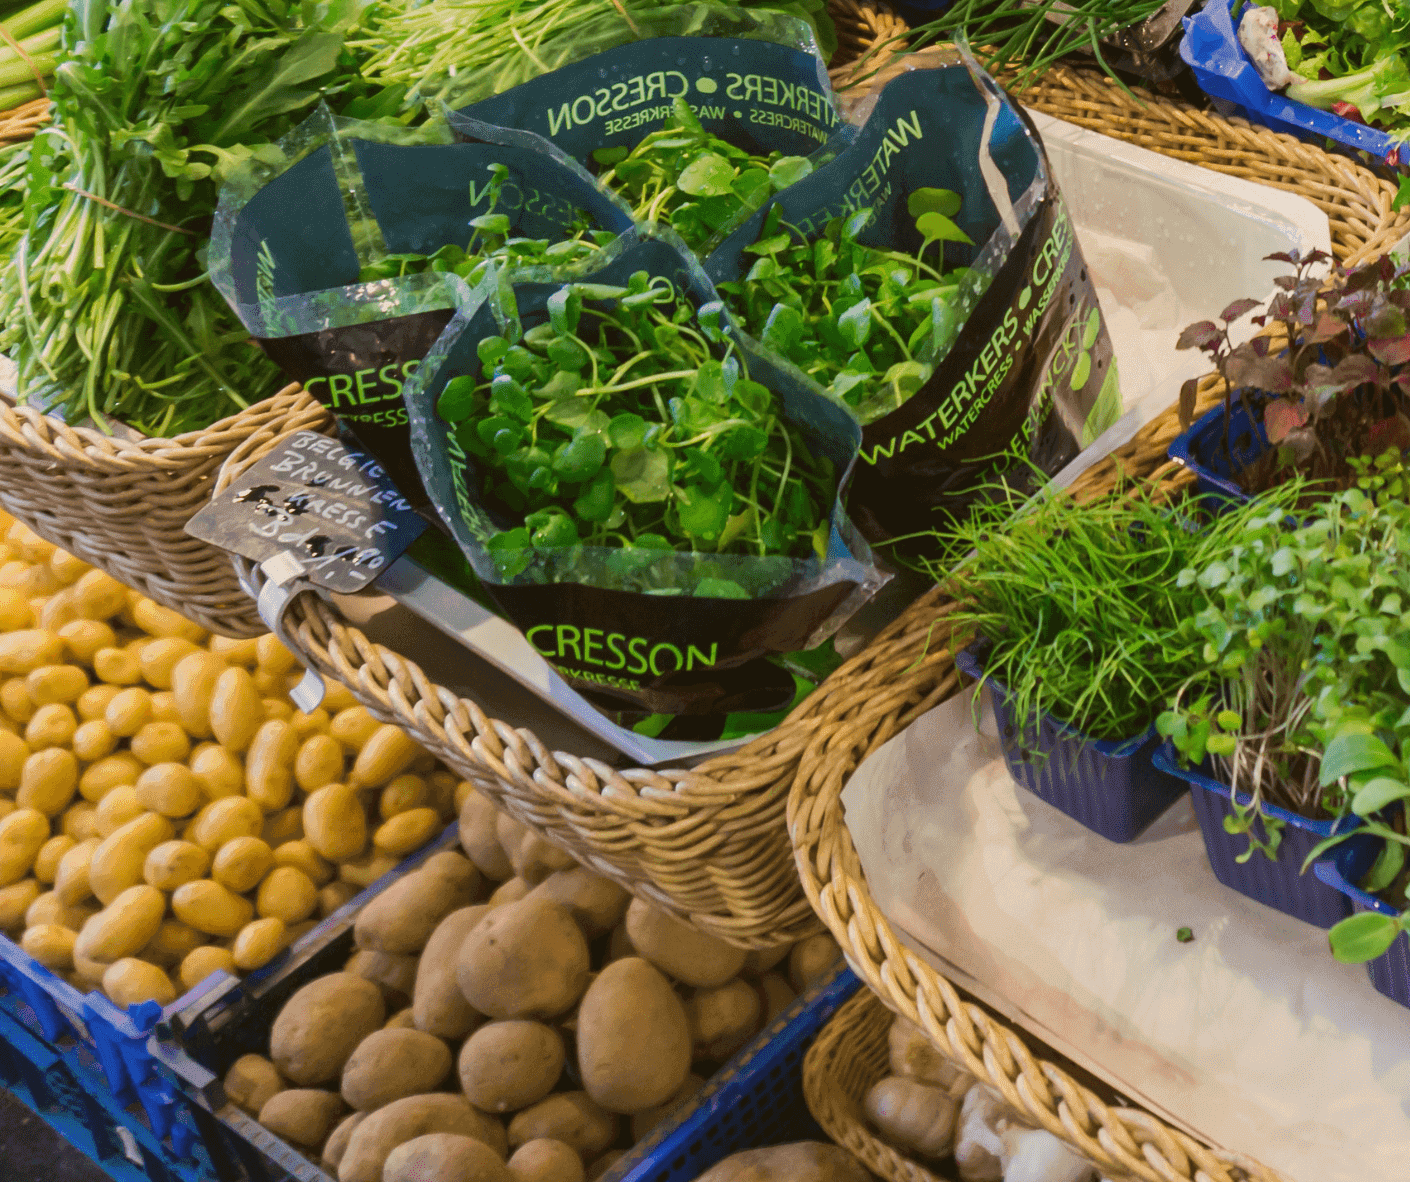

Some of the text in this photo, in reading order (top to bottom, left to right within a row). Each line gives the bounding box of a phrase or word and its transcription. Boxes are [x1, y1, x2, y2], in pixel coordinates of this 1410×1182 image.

[859, 307, 1019, 466] WATERKERS
[937, 355, 1014, 450] WATERCRESS
[270, 451, 412, 512] BRUNNEN
[526, 625, 719, 676] CRESSON
